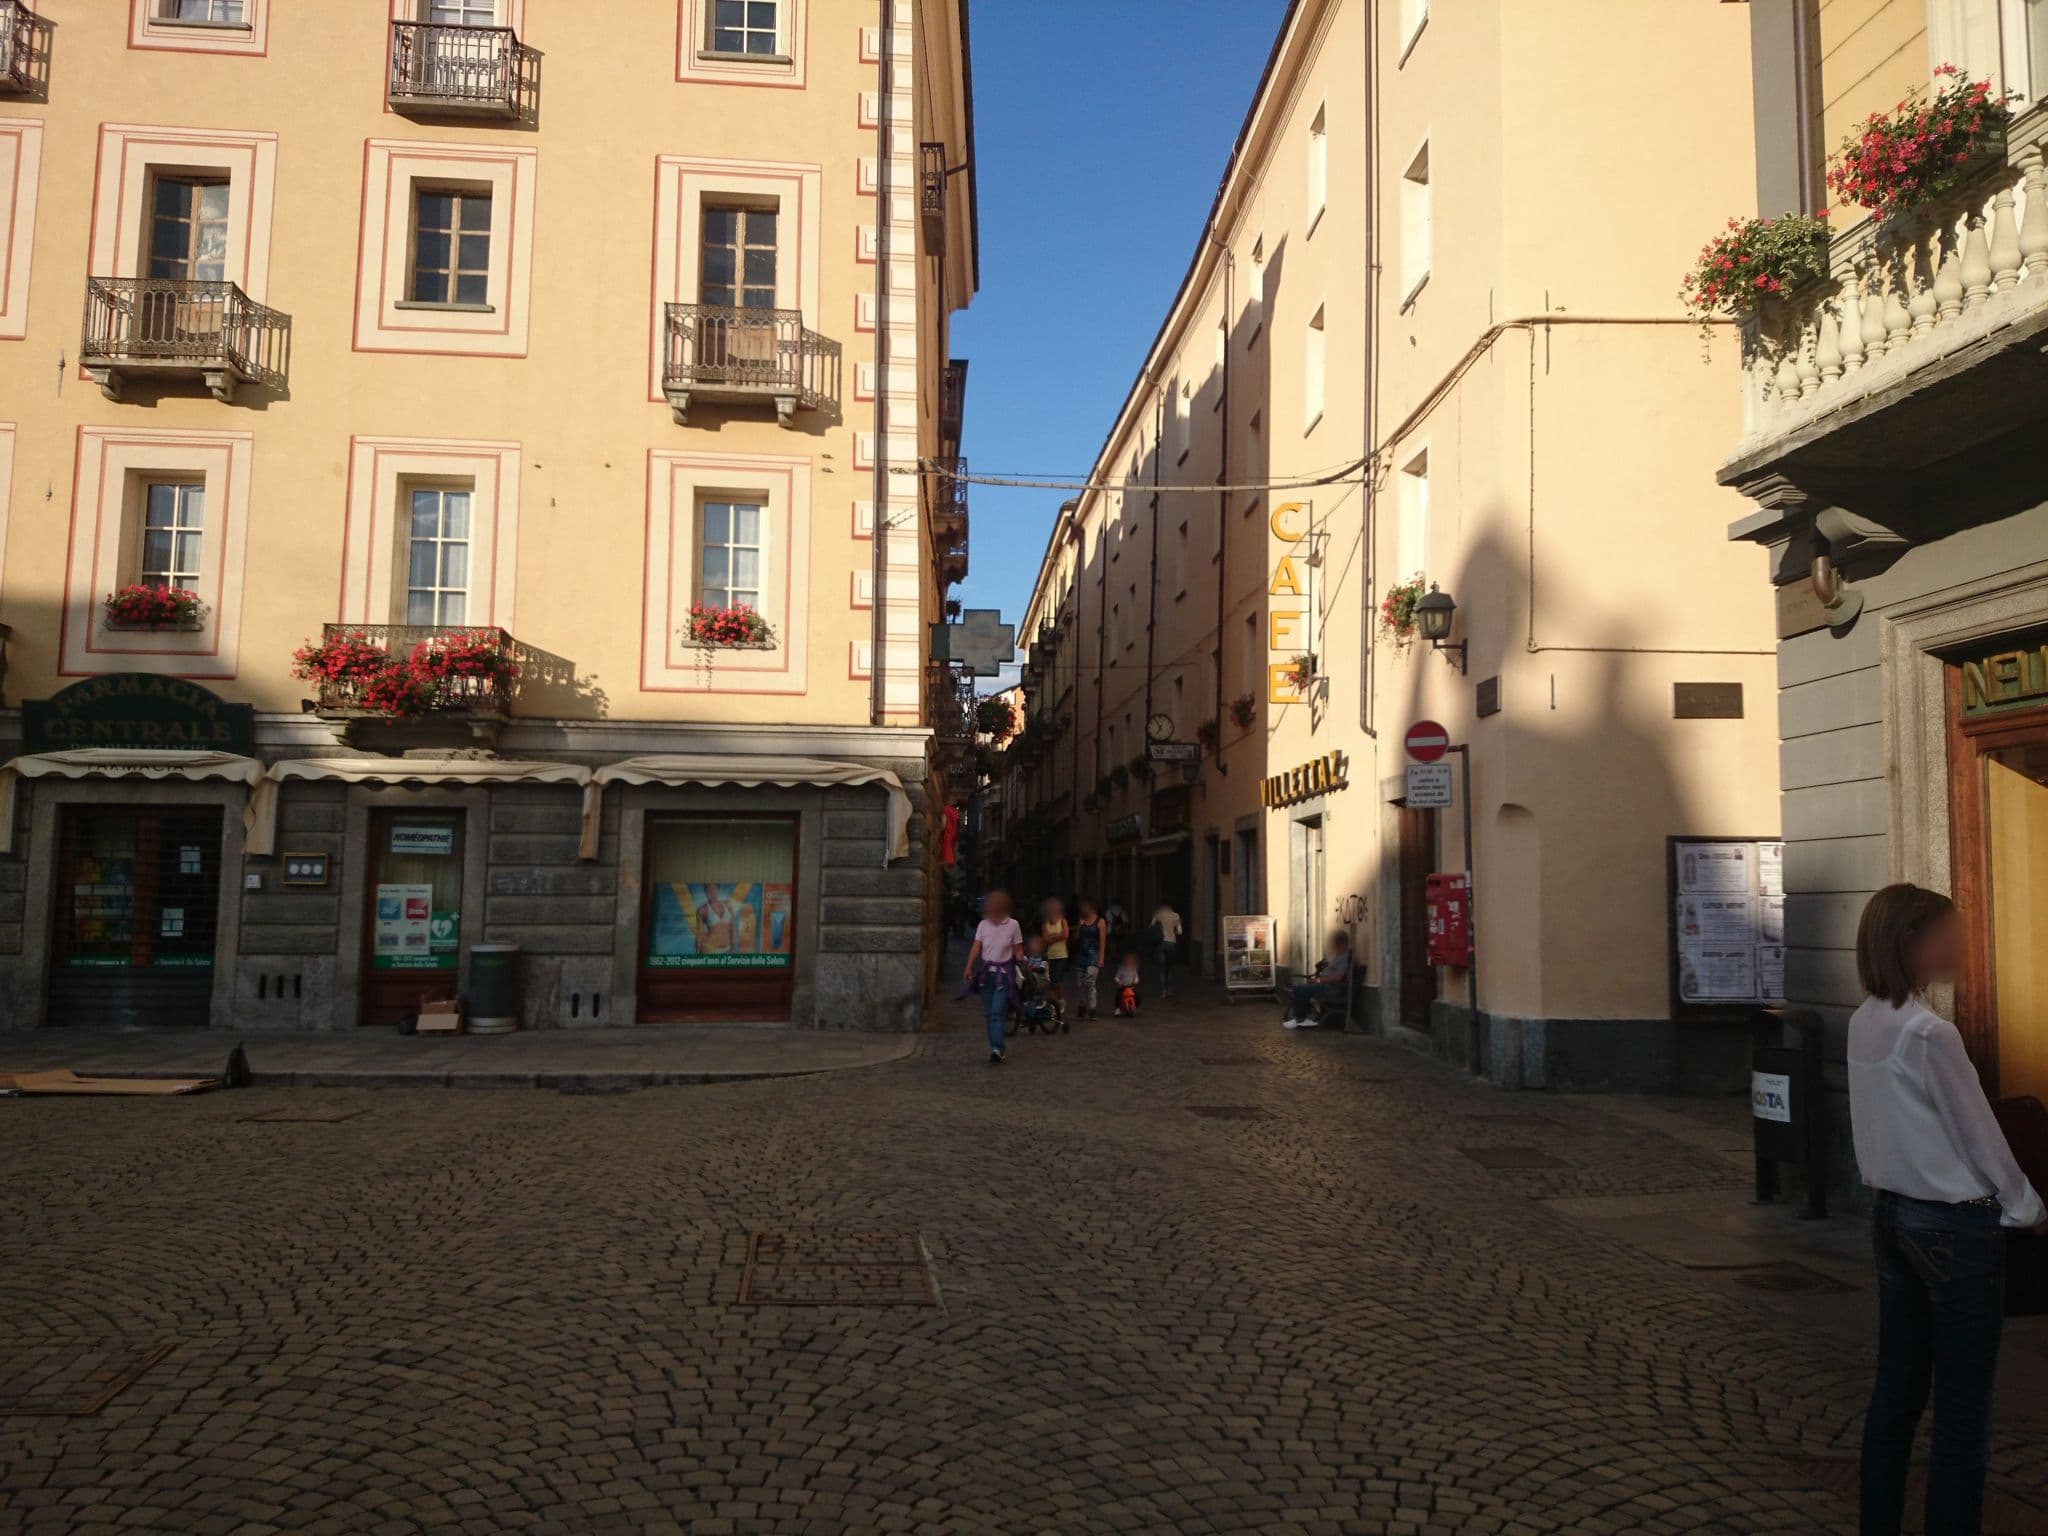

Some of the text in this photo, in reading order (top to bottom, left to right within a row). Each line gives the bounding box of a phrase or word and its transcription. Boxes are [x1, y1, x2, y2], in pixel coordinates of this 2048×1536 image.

[53, 675, 219, 719] FARMACIA
[42, 718, 233, 741] CENTRALE
[1259, 750, 1341, 808] VILLETTAZ
